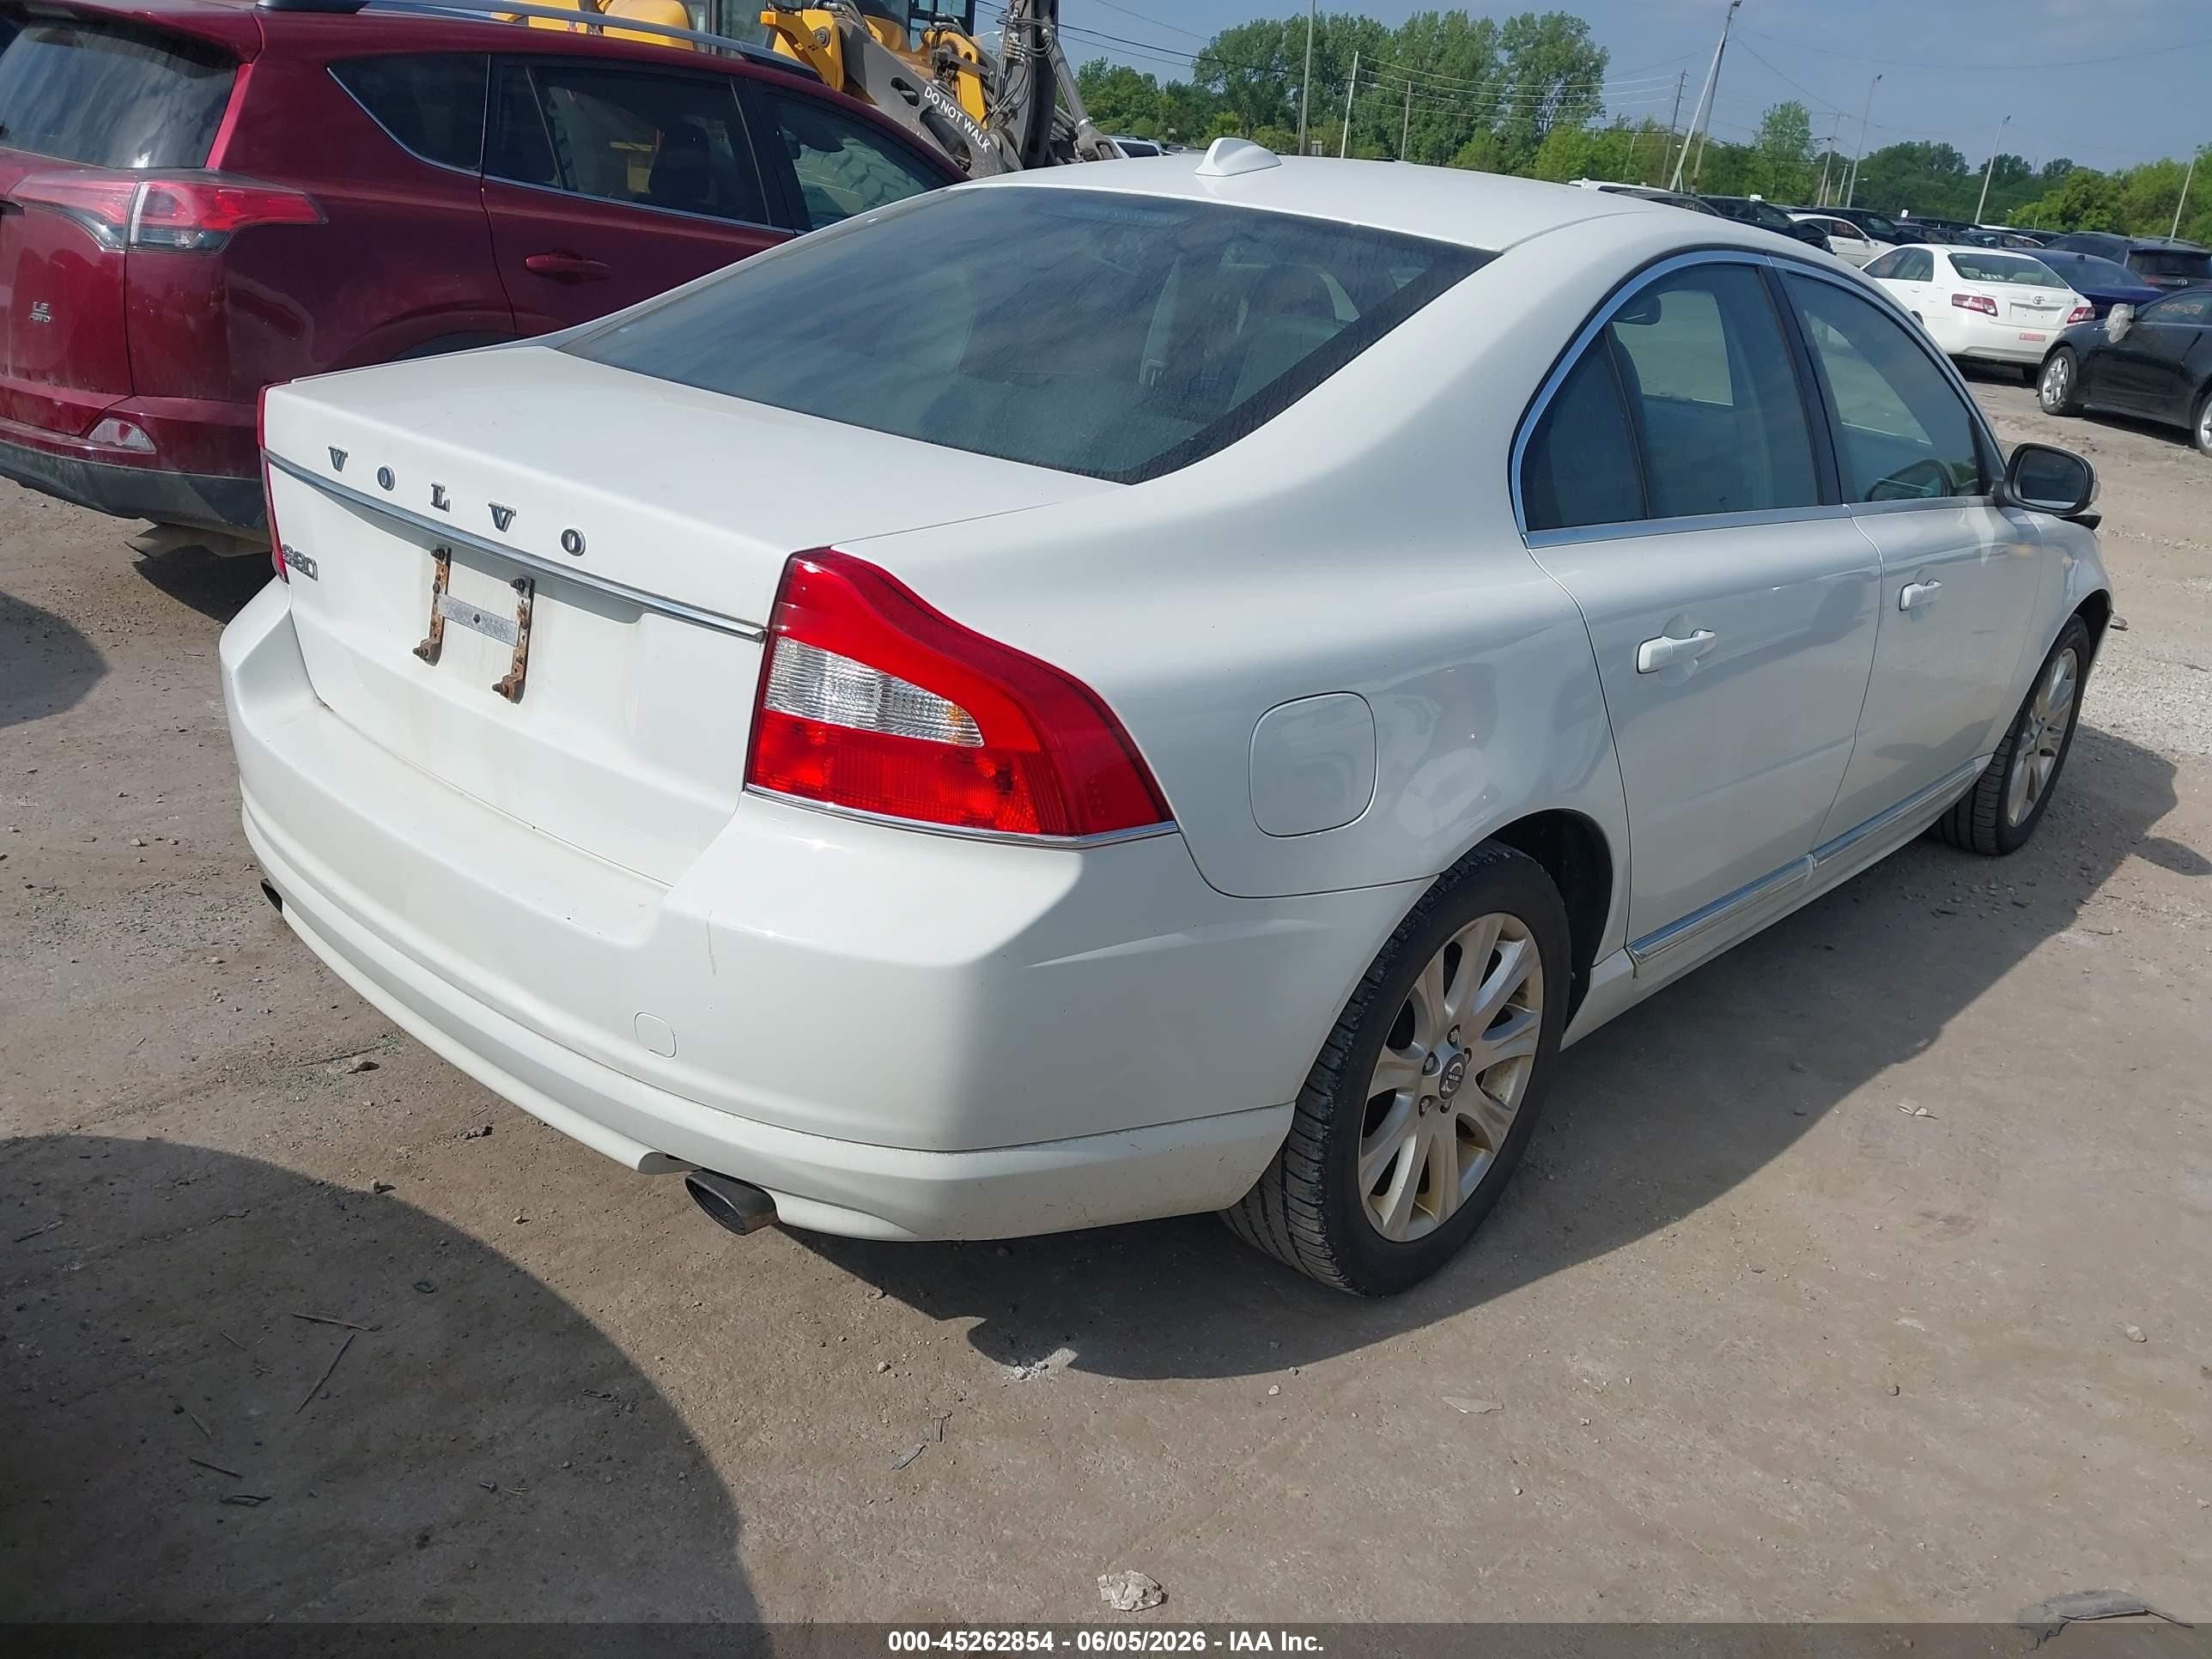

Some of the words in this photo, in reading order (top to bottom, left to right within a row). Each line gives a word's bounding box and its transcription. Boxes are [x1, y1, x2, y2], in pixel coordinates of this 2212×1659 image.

[924, 86, 939, 104] DO
[940, 100, 963, 123] NOT
[963, 118, 991, 153] WALK
[328, 445, 586, 556] VOLVO
[282, 544, 318, 581] S80
